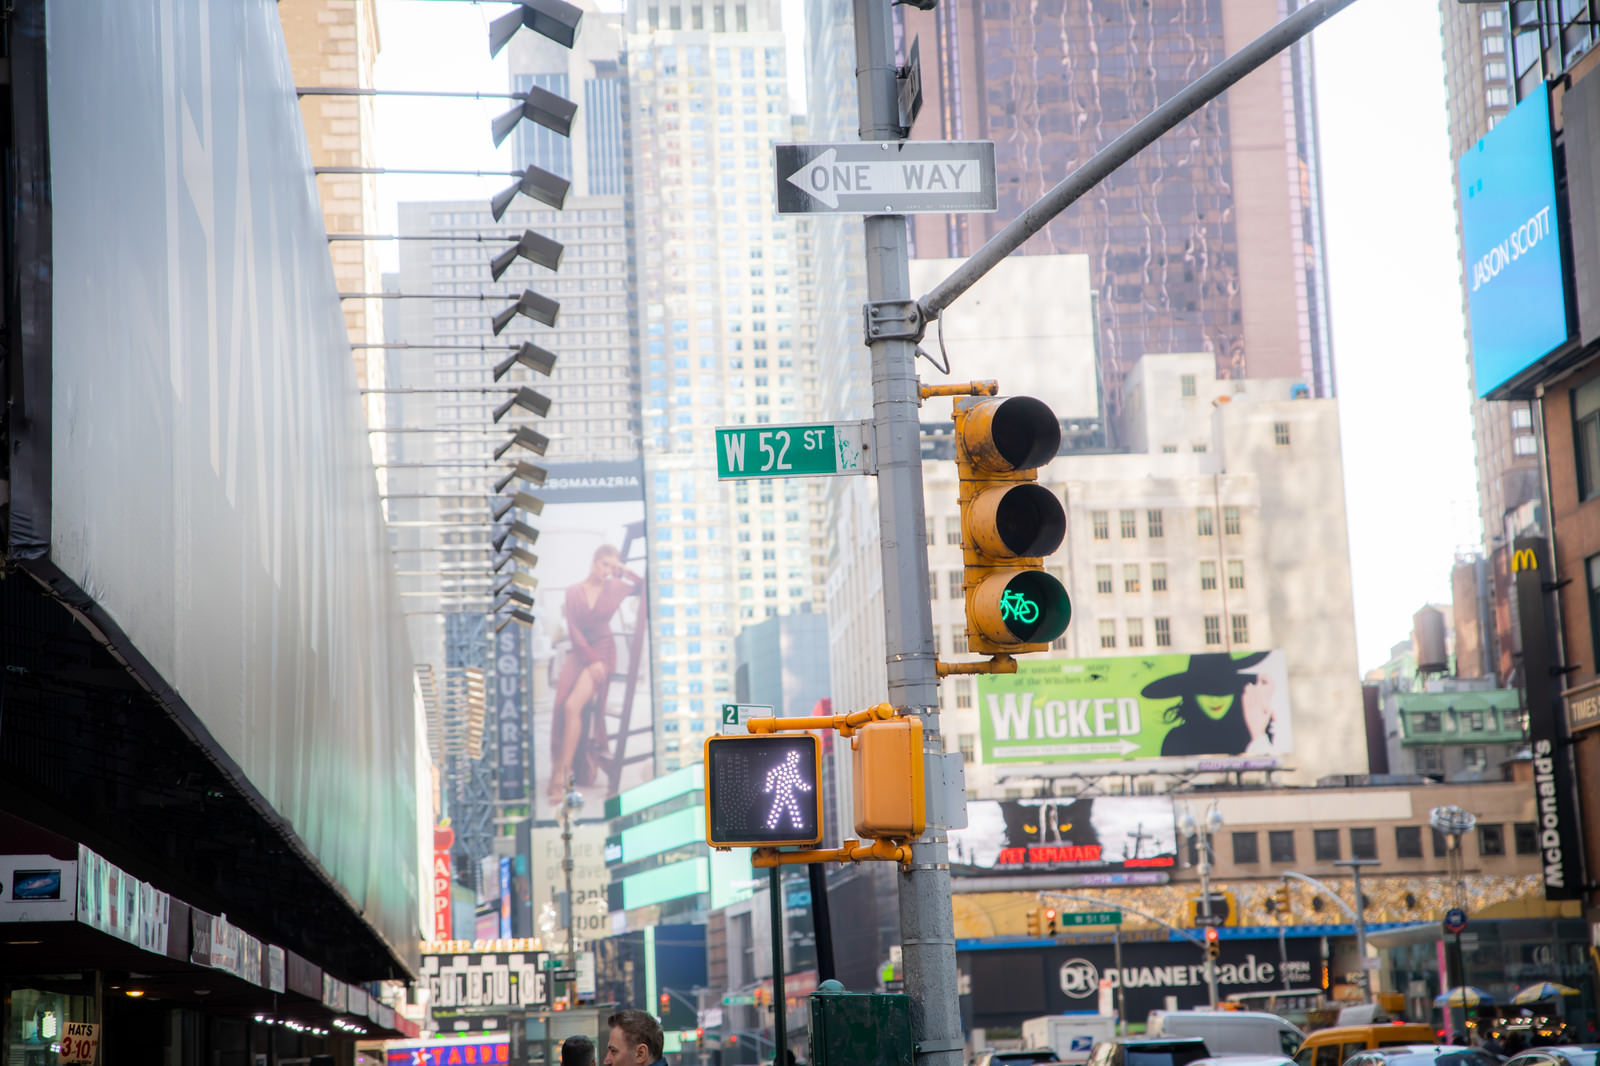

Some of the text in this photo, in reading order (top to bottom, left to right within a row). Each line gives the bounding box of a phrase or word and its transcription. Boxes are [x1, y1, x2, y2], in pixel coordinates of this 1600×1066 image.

[811, 162, 967, 192] ONE WAY
[1472, 206, 1551, 291] JASON SCOTT
[723, 429, 826, 472] W 52 ST
[497, 632, 519, 766] SQUARE
[1571, 697, 1598, 722] TIMES
[727, 706, 735, 723] 2
[1535, 739, 1564, 888] McDonald's
[1000, 845, 1102, 864] PET SEMATARY
[1060, 966, 1097, 991] DR
[1103, 966, 1187, 988] DUANE
[68, 1024, 93, 1036] HATS
